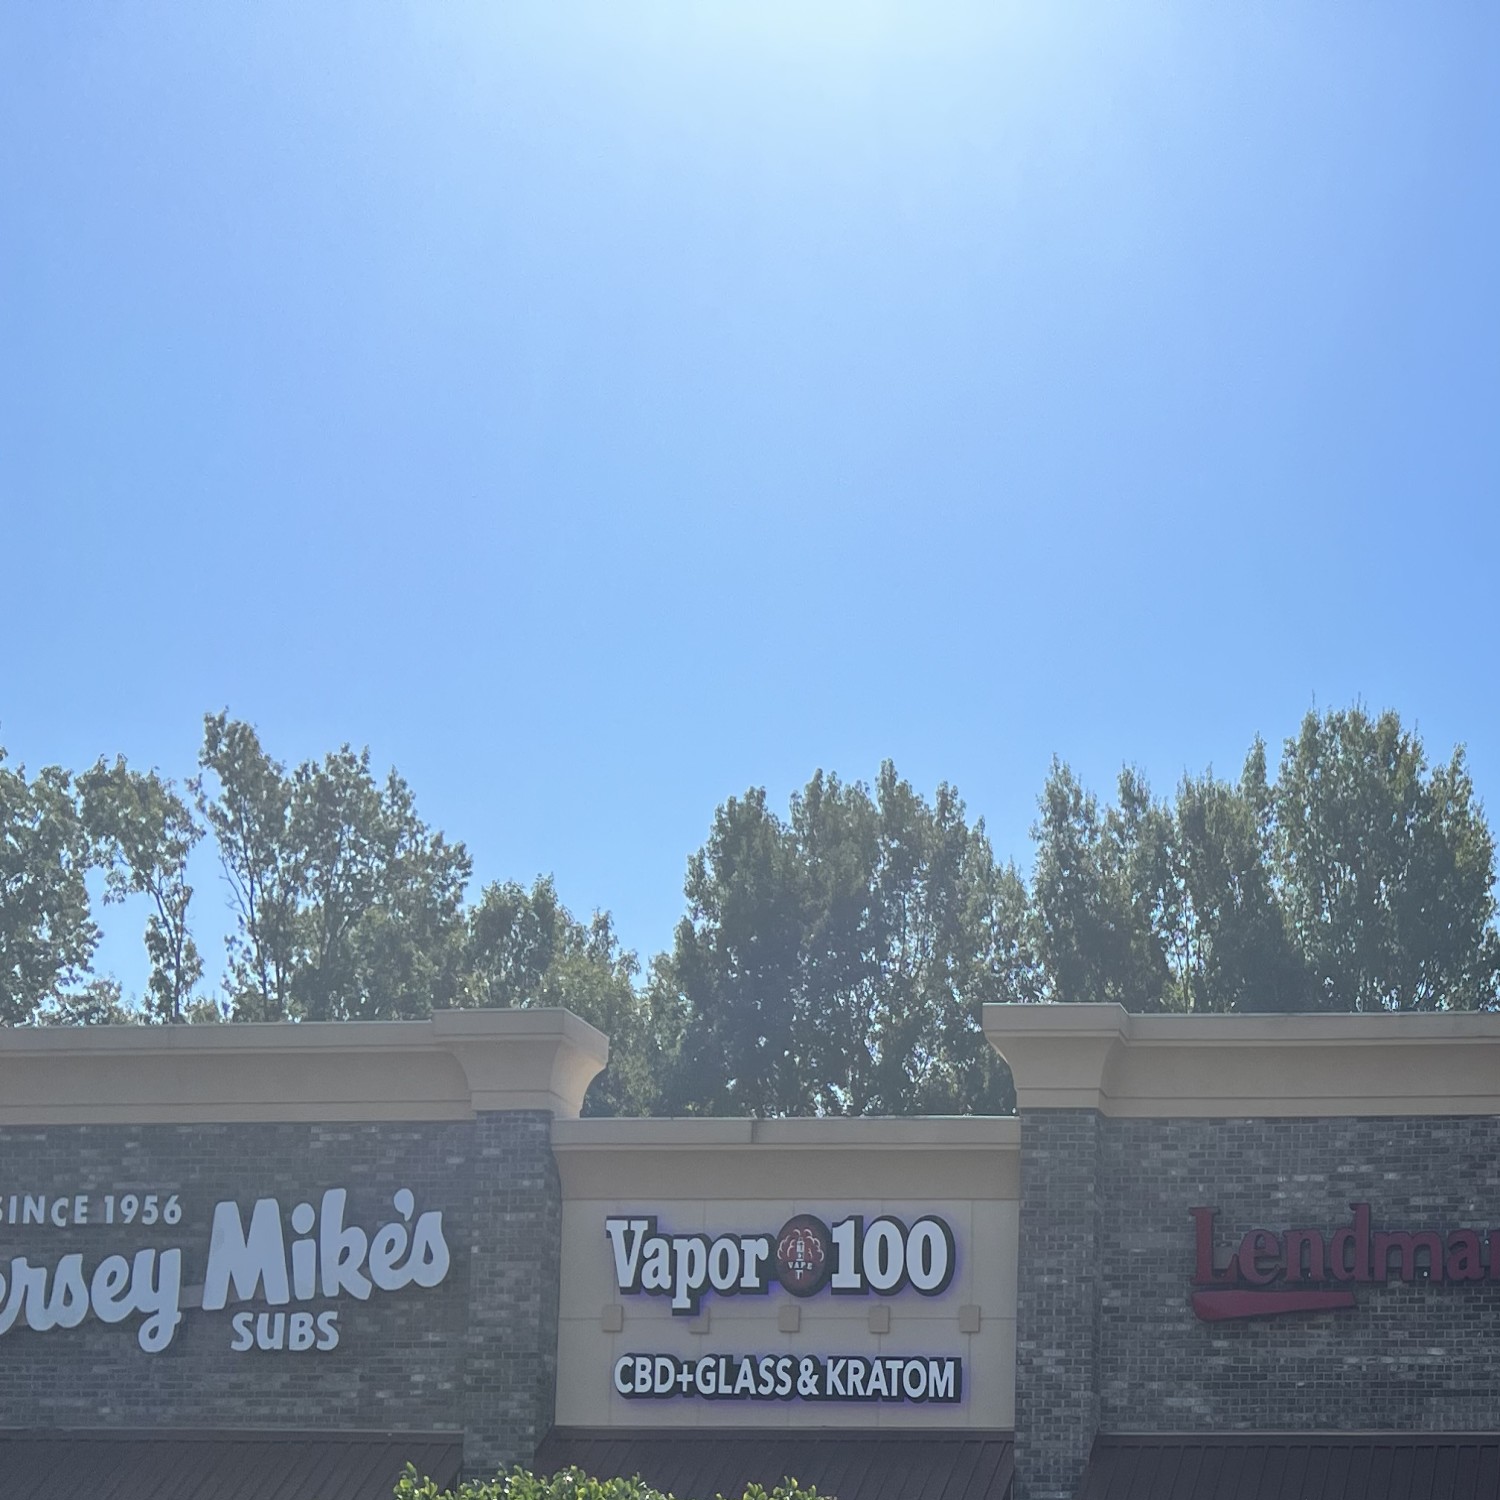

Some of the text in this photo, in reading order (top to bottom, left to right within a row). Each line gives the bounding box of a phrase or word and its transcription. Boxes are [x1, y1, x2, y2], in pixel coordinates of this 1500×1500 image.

[0, 1194, 182, 1227] INCE 1956
[0, 1188, 450, 1353] rsey Mike's
[606, 1220, 948, 1309] Vapor 100
[788, 1261, 813, 1271] VAPE
[230, 1311, 340, 1351] SUBS
[796, 1356, 819, 1396] &
[826, 1357, 955, 1398] KRATOM
